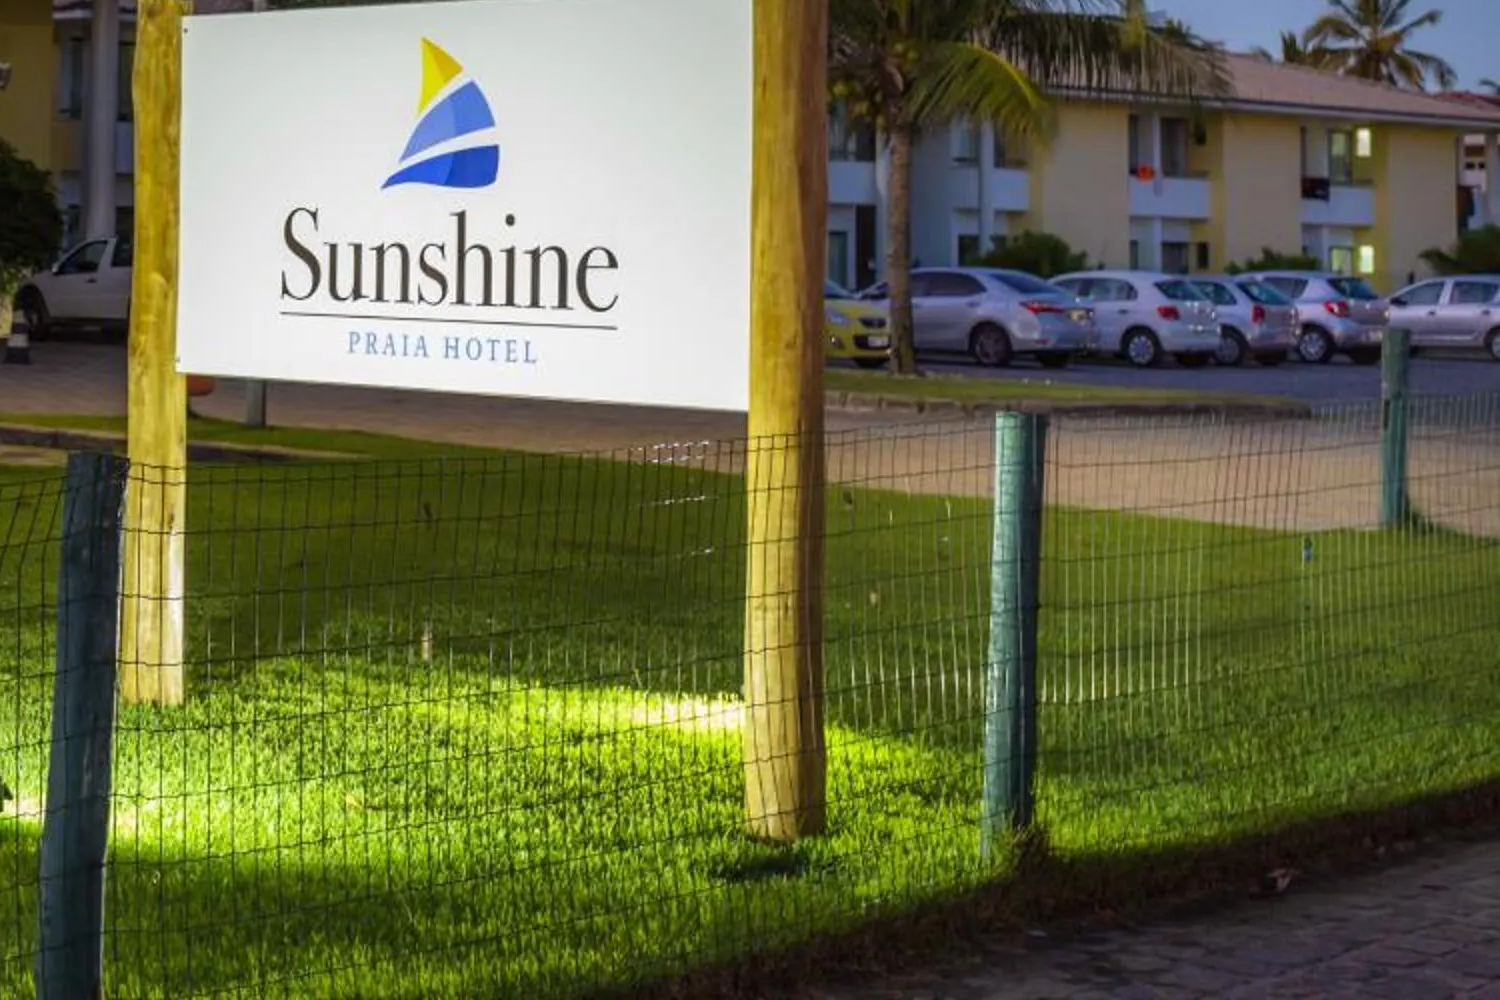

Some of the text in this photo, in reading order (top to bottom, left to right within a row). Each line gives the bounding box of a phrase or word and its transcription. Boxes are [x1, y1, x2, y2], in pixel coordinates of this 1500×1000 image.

[280, 207, 619, 312] Sunshine
[347, 331, 537, 364] PRAIA HOTEL
